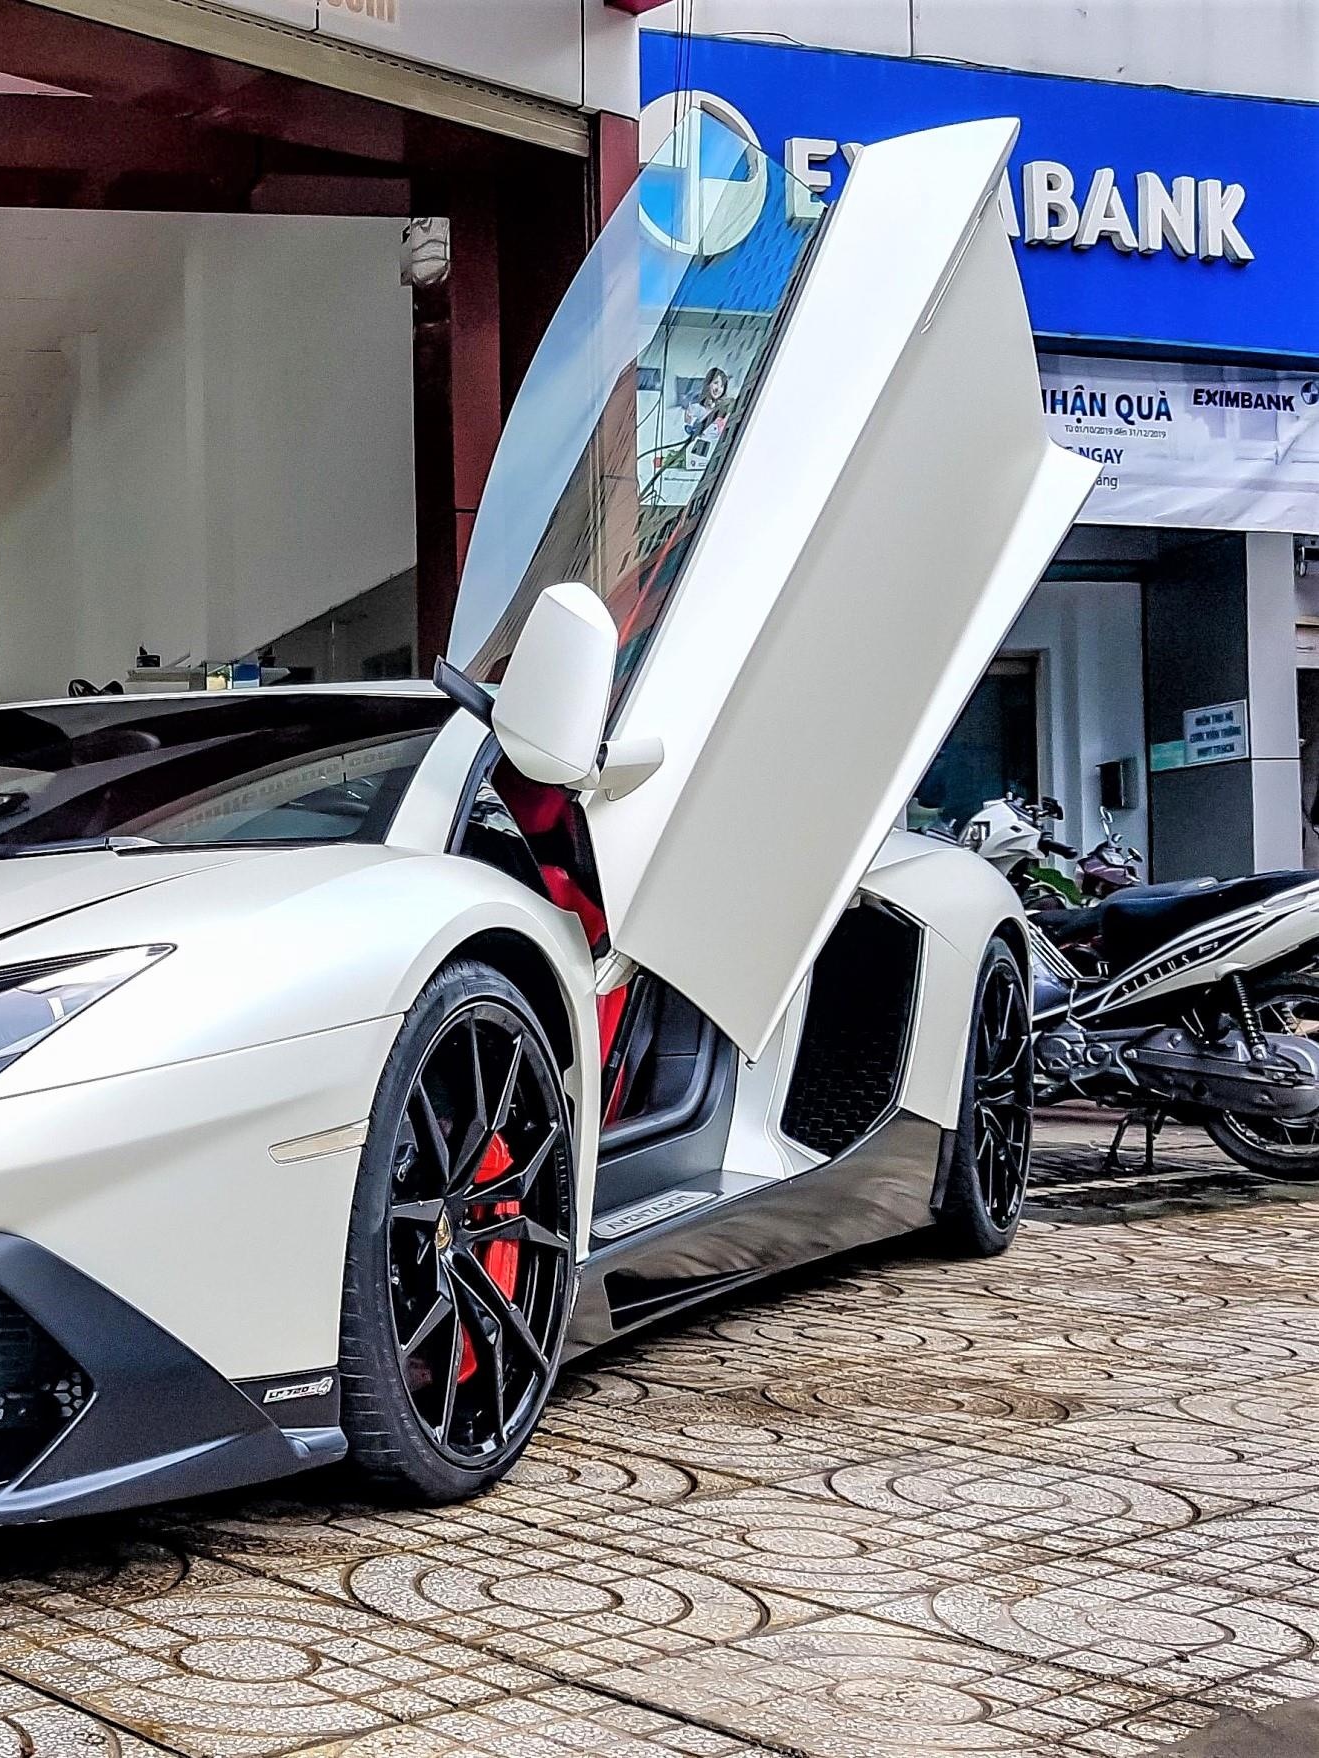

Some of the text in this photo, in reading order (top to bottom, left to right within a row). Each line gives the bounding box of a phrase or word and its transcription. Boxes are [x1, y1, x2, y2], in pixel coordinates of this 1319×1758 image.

[785, 137, 1255, 264] EBANK
[1041, 385, 1173, 425] HẬN QUÀ
[1193, 388, 1296, 412] EXIMBANK
[1128, 428, 1167, 438] 31/12/2019
[1121, 954, 1190, 997] SIRIUS
